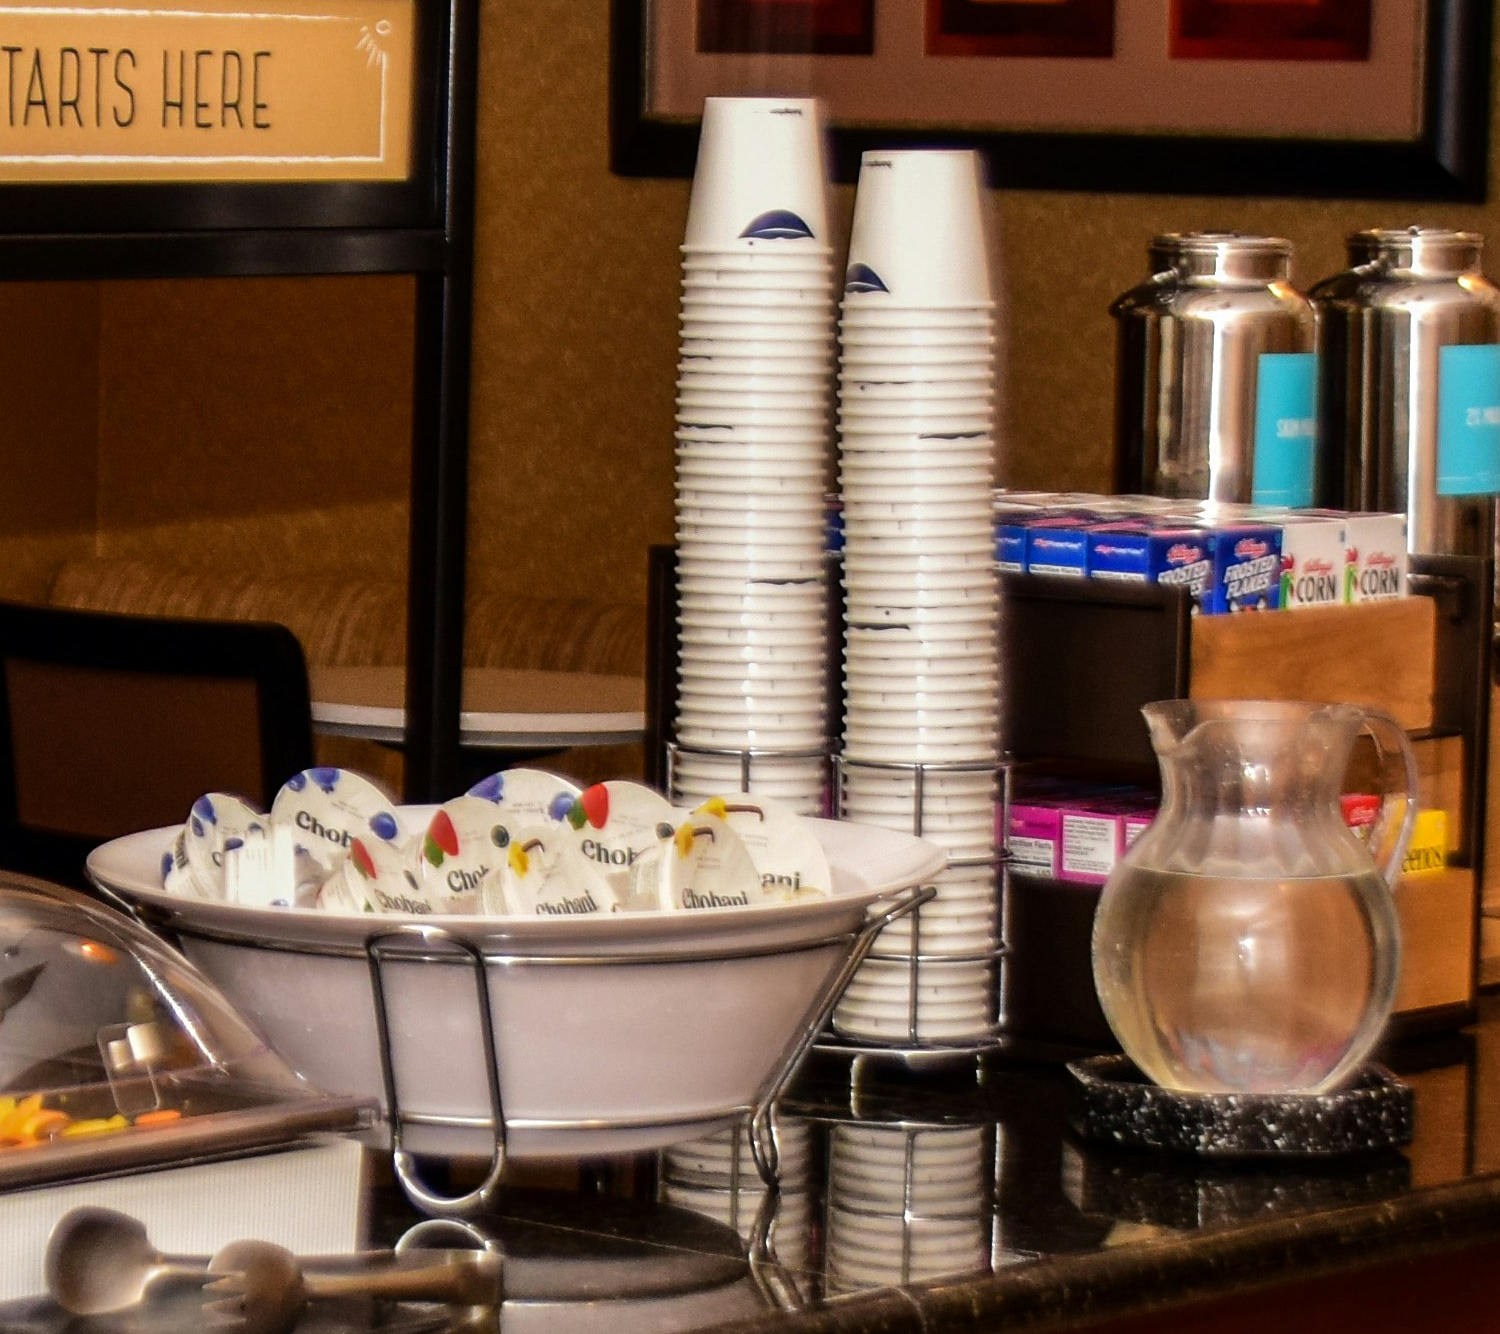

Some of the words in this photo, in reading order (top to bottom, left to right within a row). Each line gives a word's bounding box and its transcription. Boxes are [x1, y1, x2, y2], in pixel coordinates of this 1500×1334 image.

[161, 48, 272, 129] HERE
[1295, 574, 1336, 603] CORN
[1360, 567, 1399, 595] CORN
[536, 888, 598, 914] Chobani
[682, 886, 749, 909] Chobani
